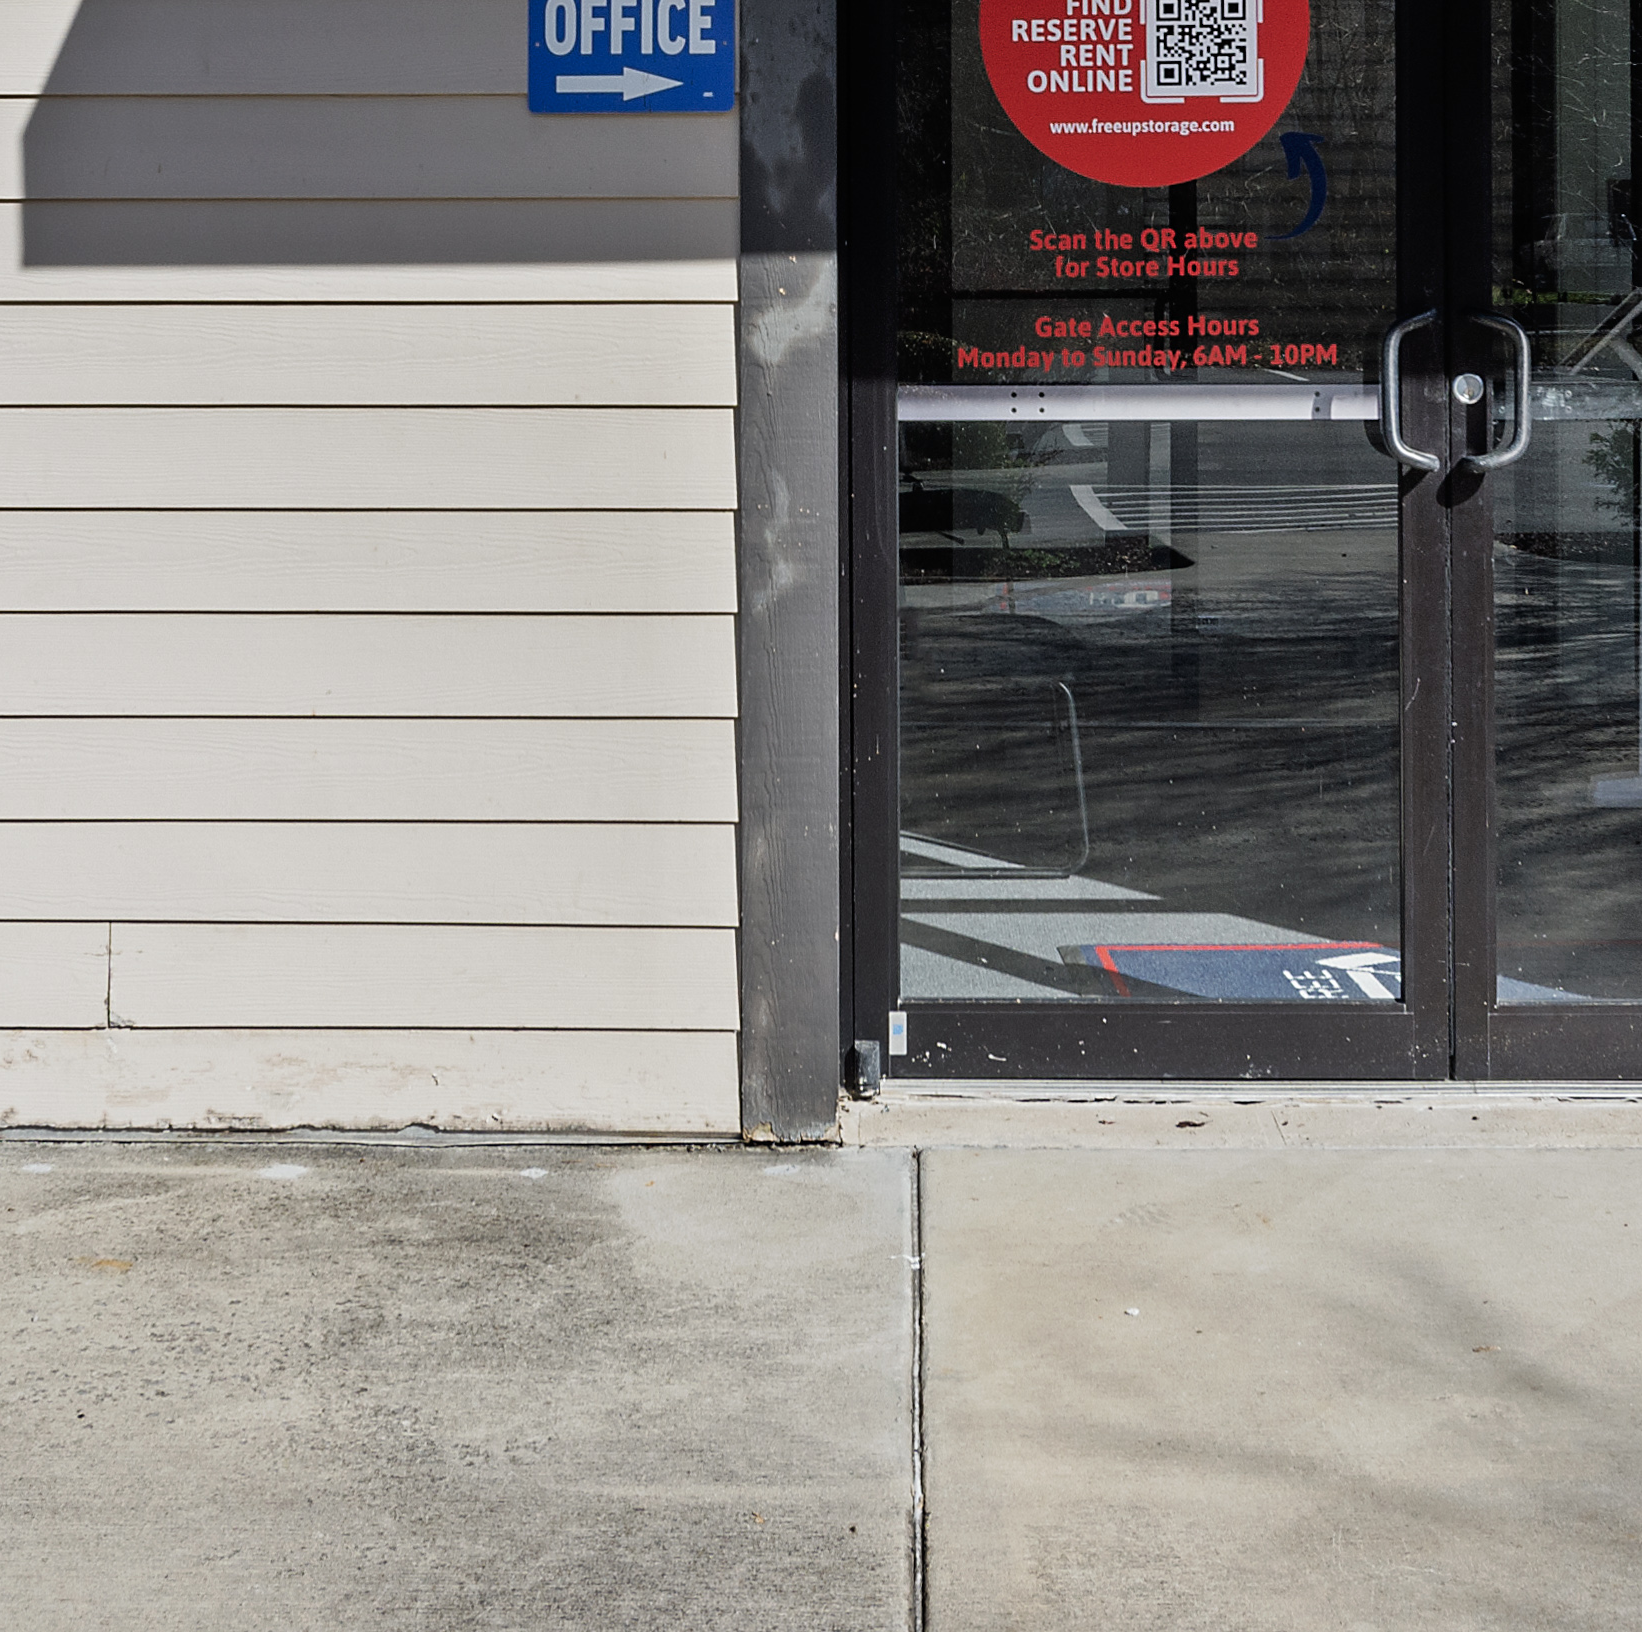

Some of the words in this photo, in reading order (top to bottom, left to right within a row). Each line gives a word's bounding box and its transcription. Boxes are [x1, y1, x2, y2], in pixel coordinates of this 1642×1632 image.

[1011, 19, 1133, 42] RESERVE
[1060, 44, 1133, 67] RENT
[1027, 70, 1133, 93] ONLINE
[1050, 119, 1235, 136] www.freeupstorage.com
[1029, 229, 1087, 251] Scan
[1094, 228, 1135, 250] the
[1140, 228, 1177, 253] QR
[1184, 227, 1258, 249] above
[1055, 256, 1091, 278] for
[1096, 255, 1159, 277] Store
[1167, 255, 1239, 277] Hours
[1035, 316, 1092, 337] Gate
[1099, 316, 1180, 337] Access
[1187, 315, 1259, 336] Hours
[958, 346, 1055, 373] Monday
[1061, 348, 1085, 367] to
[1093, 344, 1187, 371] Sunday,
[1194, 345, 1247, 367] 6AM
[1269, 343, 1338, 366] 10PM
